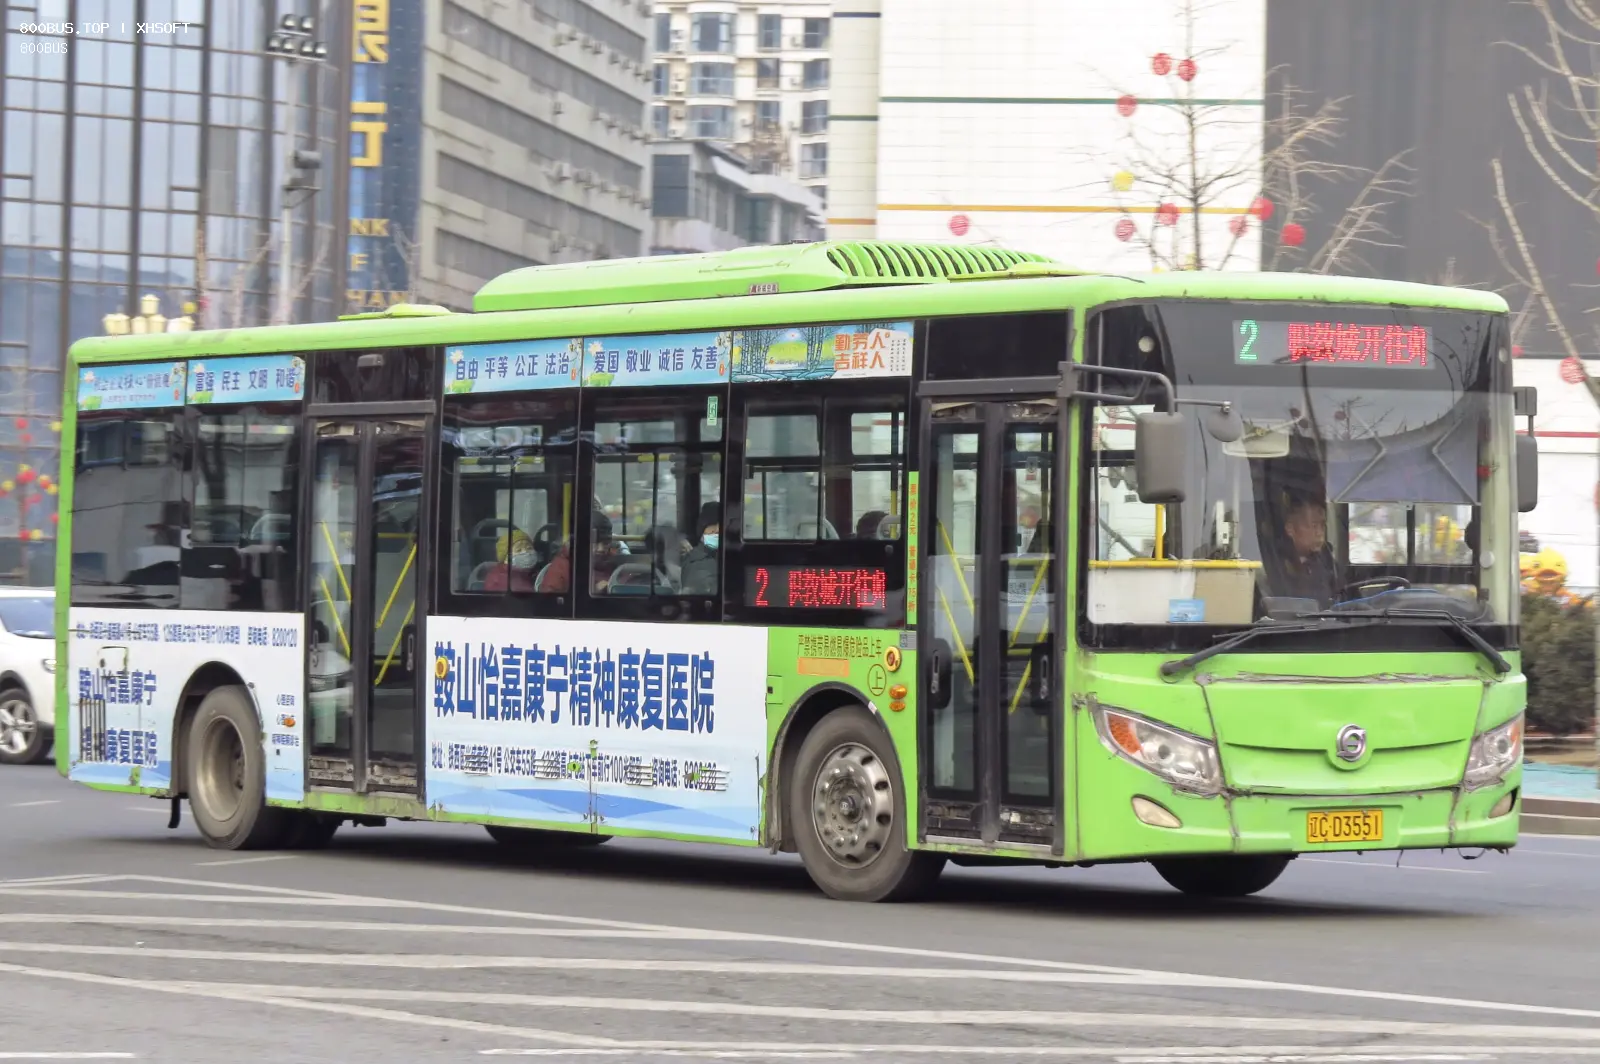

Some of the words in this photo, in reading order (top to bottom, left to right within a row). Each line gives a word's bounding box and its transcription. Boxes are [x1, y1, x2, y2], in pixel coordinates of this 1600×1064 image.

[349, 218, 390, 236] NK
[350, 253, 368, 271] F
[1239, 319, 1259, 360] 2
[456, 358, 479, 381] 自由
[484, 356, 509, 379] 平等
[514, 354, 539, 377] 公正
[545, 352, 570, 375] 法治
[593, 350, 619, 374] 爱国
[625, 348, 651, 373] 敬业
[657, 348, 685, 372] 诚信
[690, 346, 718, 370] 友善
[834, 351, 885, 371] 吉祥人
[221, 370, 240, 391] 民主
[248, 368, 268, 389] 文明
[755, 568, 769, 606] 2
[433, 640, 715, 734] 鞍山怡嘉康宁精神康复医院
